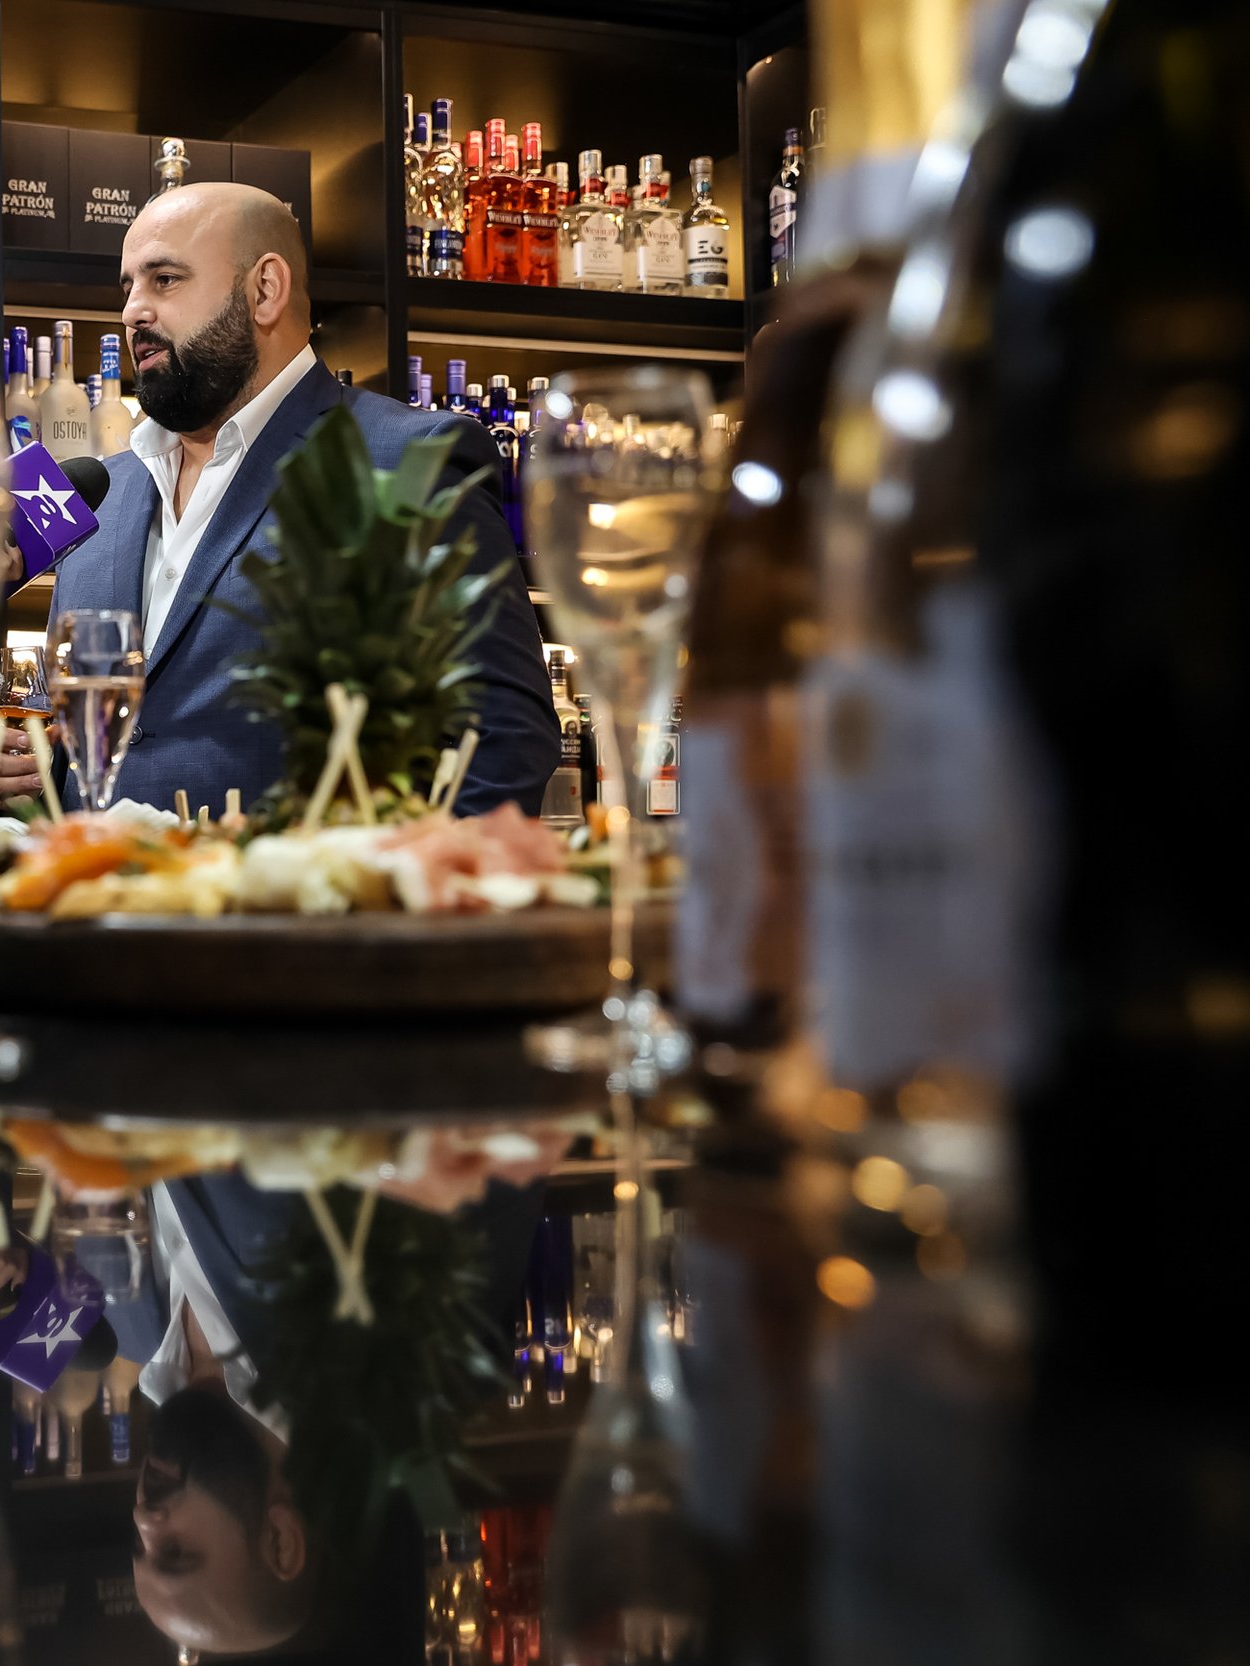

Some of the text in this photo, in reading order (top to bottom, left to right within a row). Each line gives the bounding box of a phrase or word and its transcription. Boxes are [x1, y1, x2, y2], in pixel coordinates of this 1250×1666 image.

[8, 179, 47, 193] GRAN
[1, 194, 54, 209] PATRÓN
[92, 187, 130, 202] GRAN
[86, 202, 137, 218] PATRÓN
[53, 421, 87, 440] OSTOYA
